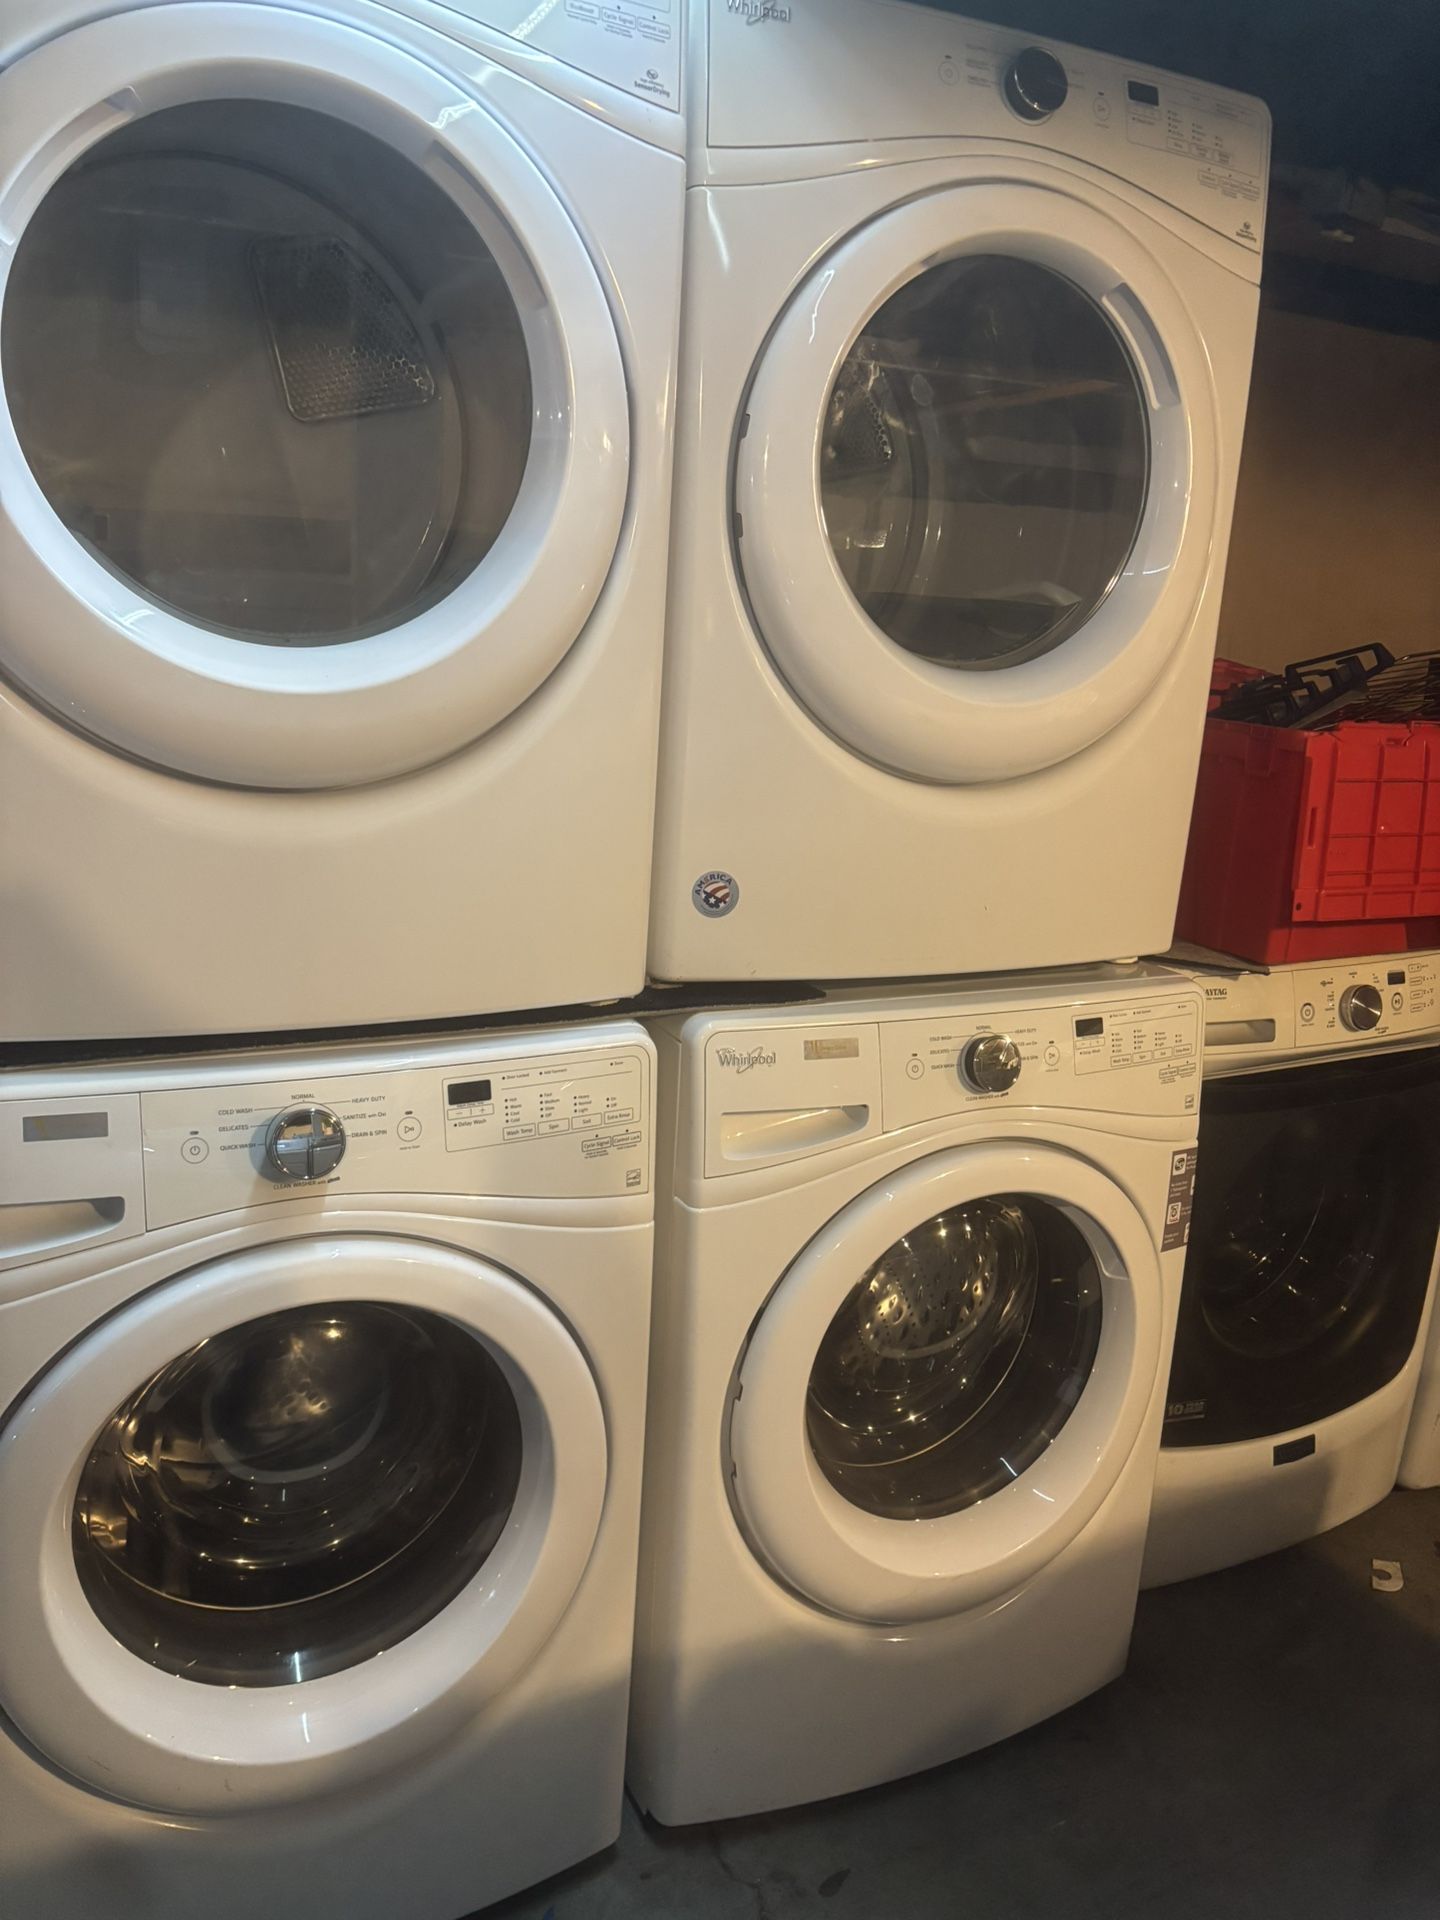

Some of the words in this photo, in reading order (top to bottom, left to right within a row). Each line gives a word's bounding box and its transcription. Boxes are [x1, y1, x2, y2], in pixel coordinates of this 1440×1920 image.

[728, 0, 792, 25] Whirlpool
[695, 873, 733, 896] AMERICA
[716, 1047, 777, 1073] Whirlpool
